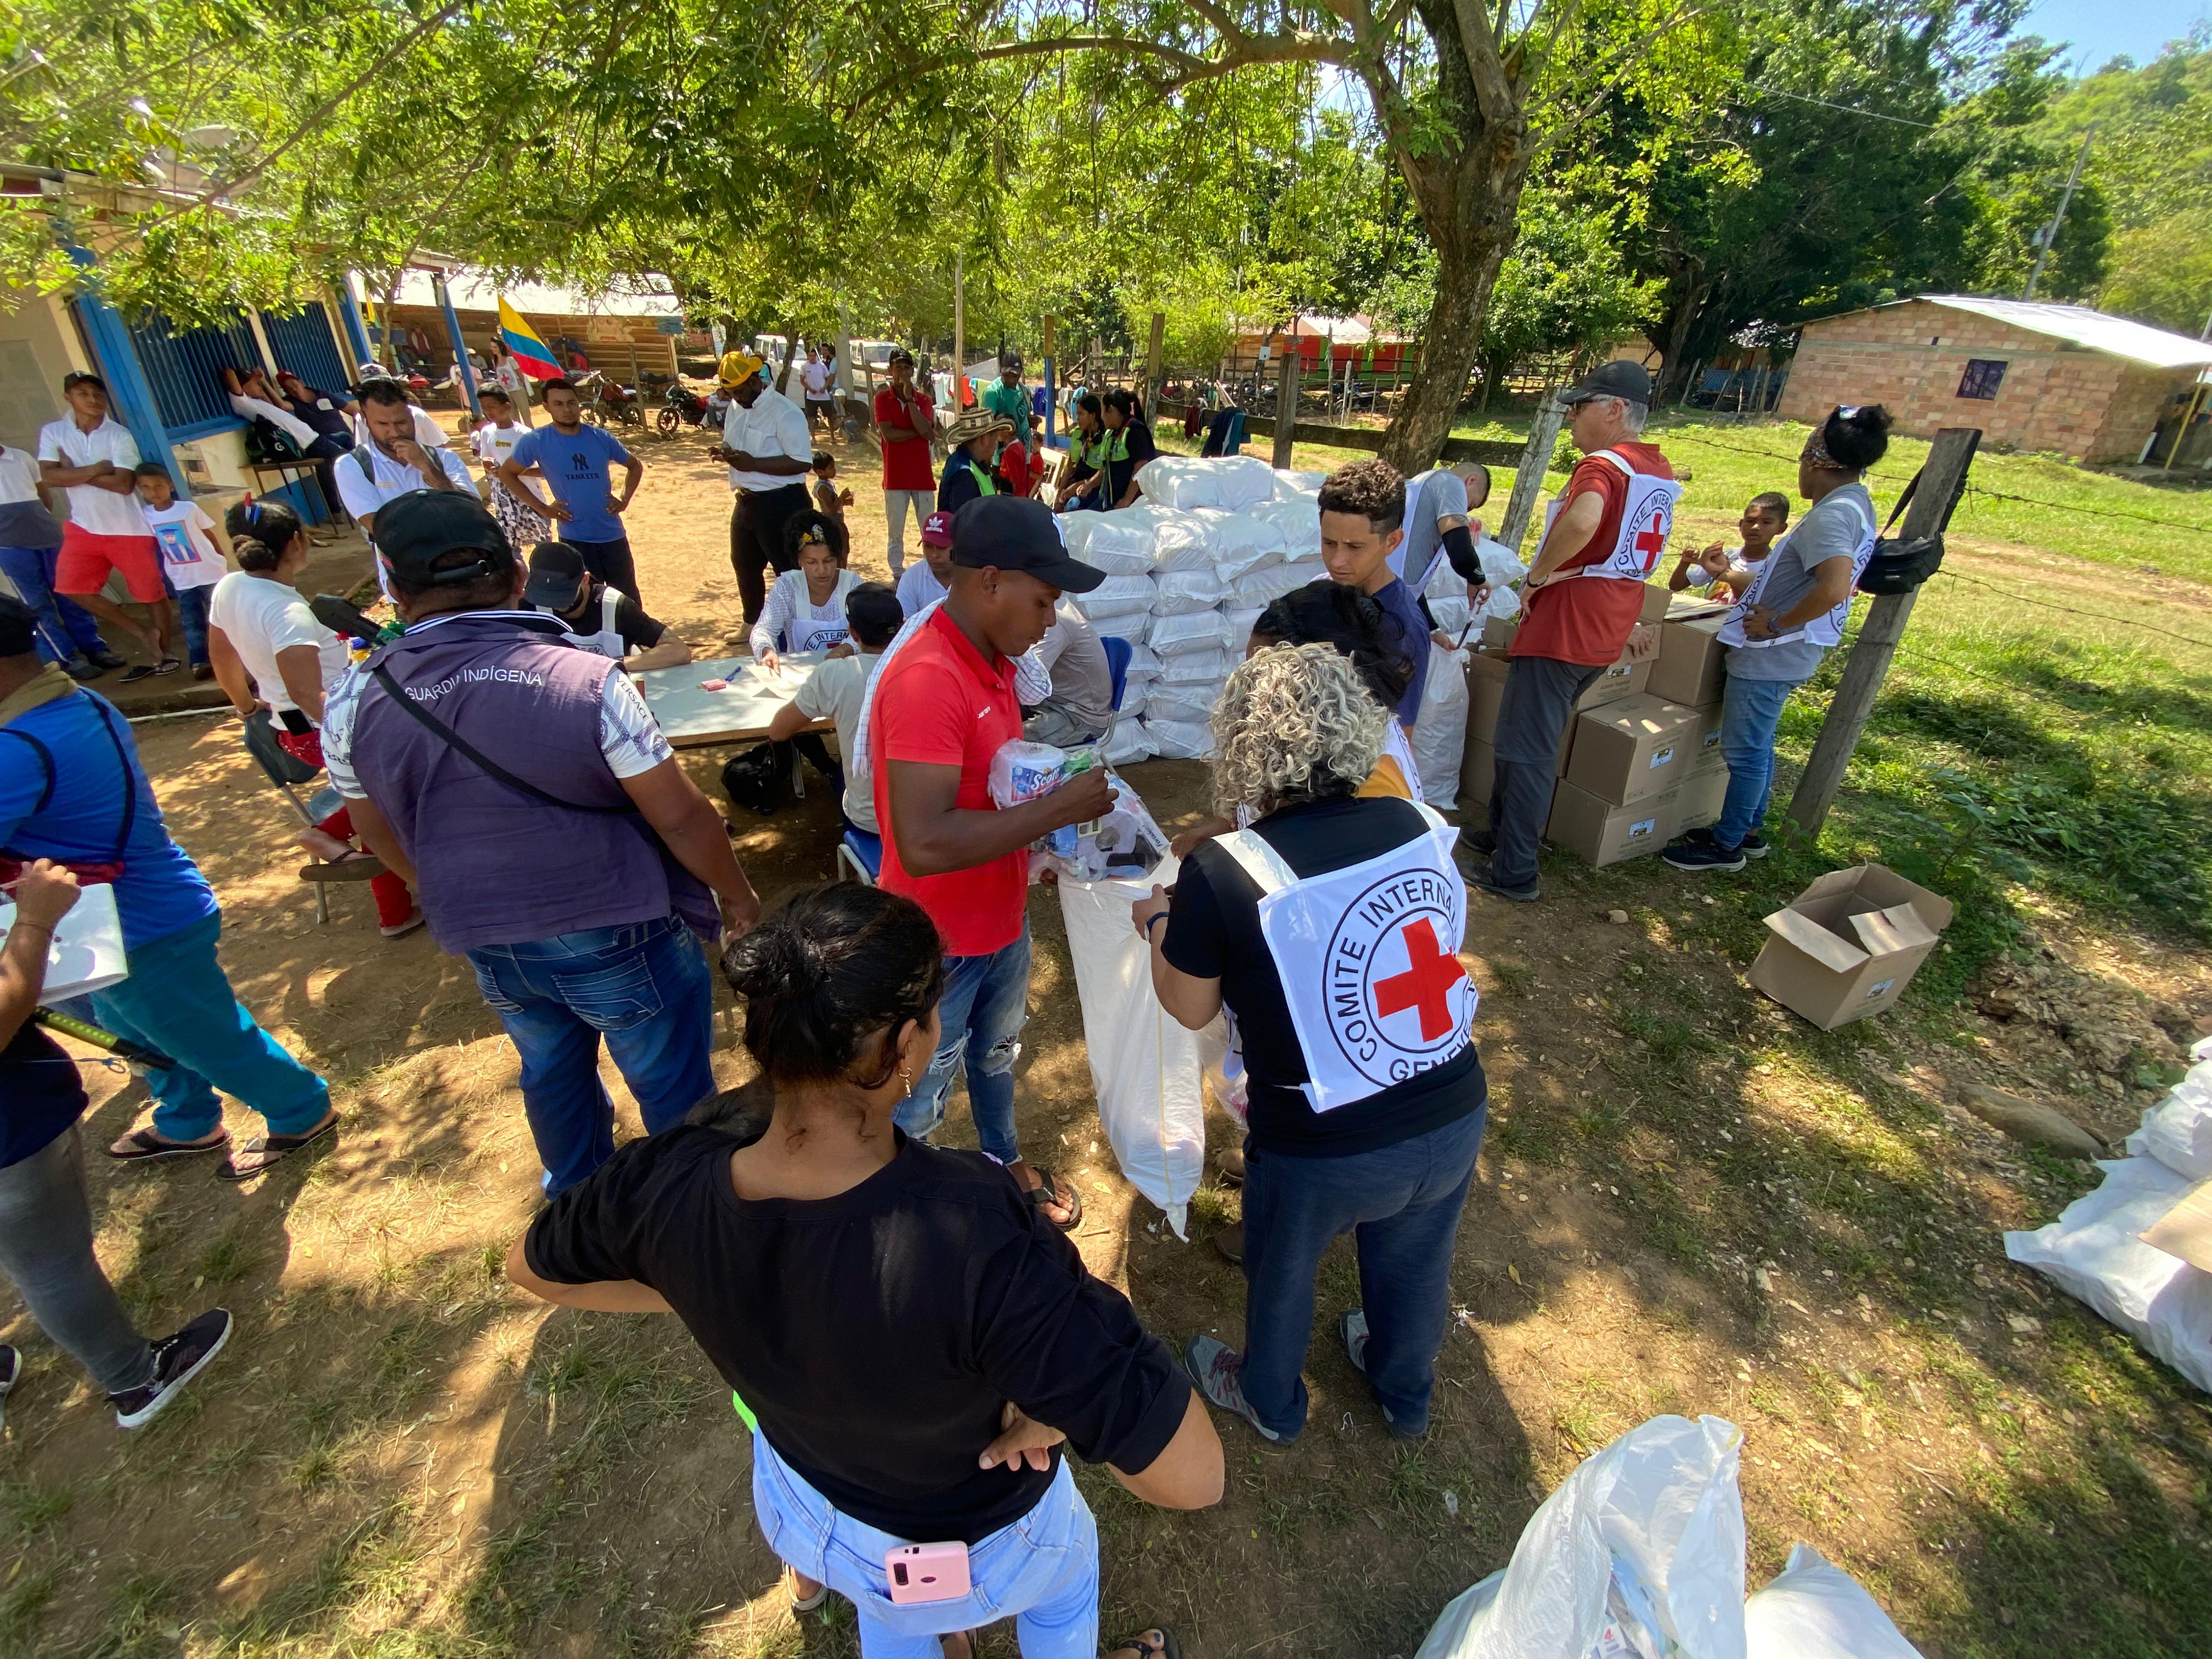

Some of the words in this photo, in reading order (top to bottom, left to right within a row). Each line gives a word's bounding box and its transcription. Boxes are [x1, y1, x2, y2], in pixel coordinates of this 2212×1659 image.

[464, 665, 542, 686] INDÍGENA
[617, 675, 648, 721] VERSACE
[1335, 937, 1377, 1062] COMITE
